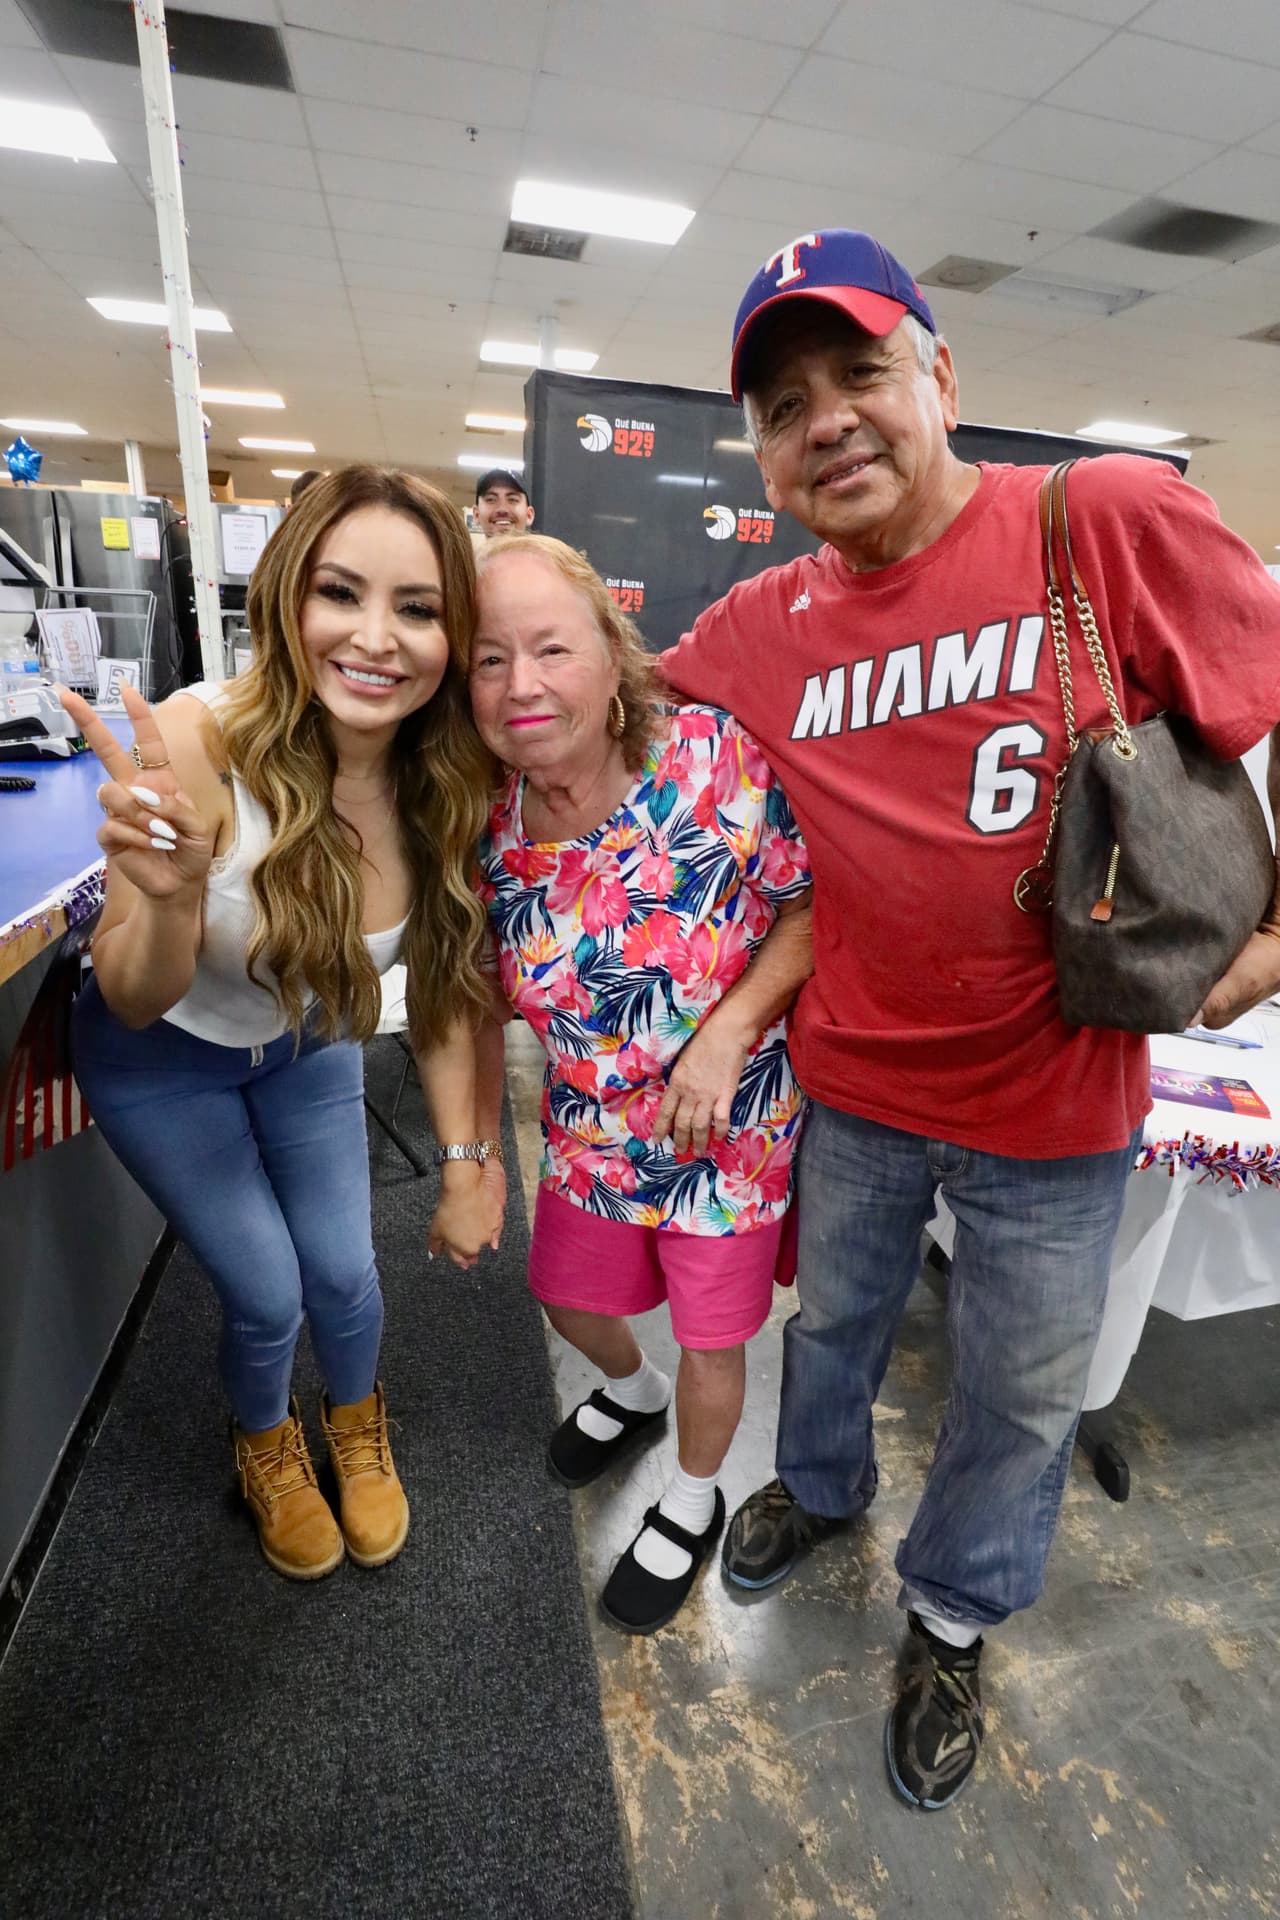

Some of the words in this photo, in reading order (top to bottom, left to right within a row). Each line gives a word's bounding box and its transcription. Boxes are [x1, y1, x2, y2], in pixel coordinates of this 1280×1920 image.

[765, 234, 822, 289] T
[631, 419, 656, 432] BUENA
[753, 508, 775, 520] BUENA
[621, 579, 645, 590] BUENA
[788, 613, 1046, 741] MIAMI
[964, 719, 1049, 837] 6
